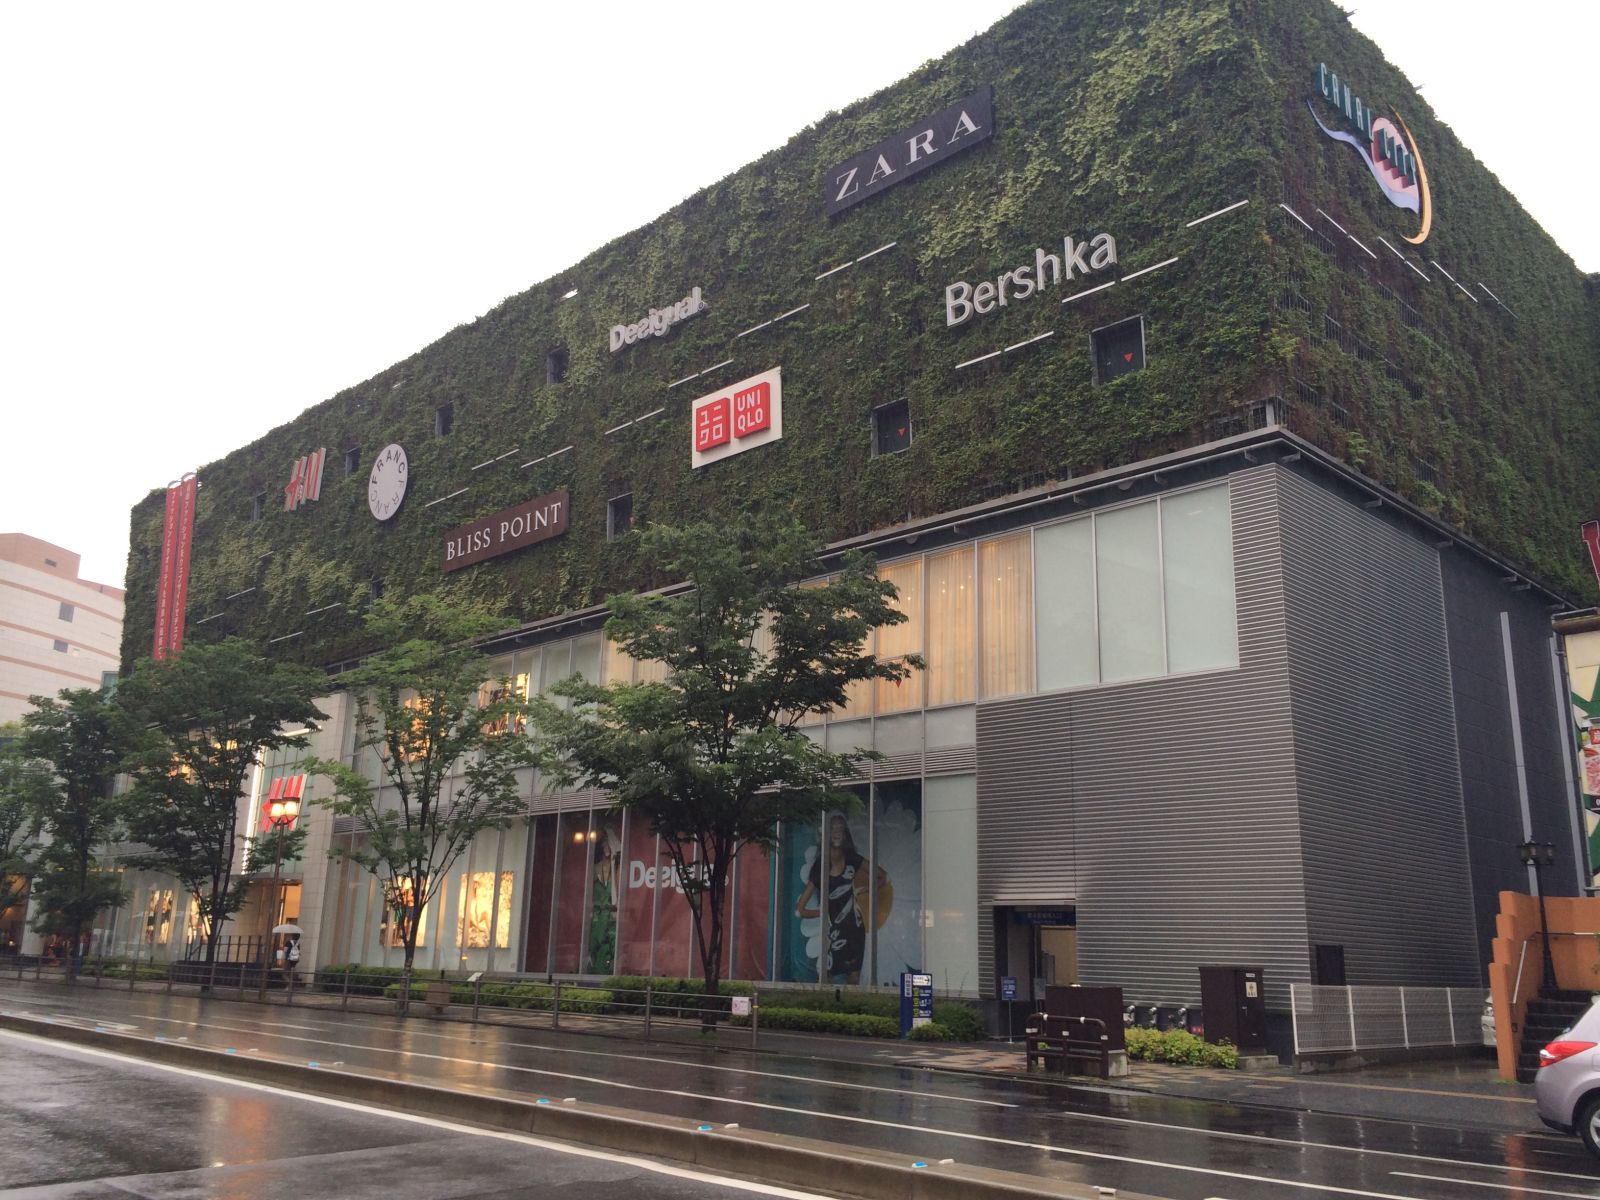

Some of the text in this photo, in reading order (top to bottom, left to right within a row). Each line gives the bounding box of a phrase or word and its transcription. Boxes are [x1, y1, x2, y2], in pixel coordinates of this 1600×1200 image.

[834, 109, 982, 203] ZARA
[1319, 62, 1417, 186] CANAL CITY
[945, 232, 1118, 327] Bershka
[609, 286, 703, 353] Desigual
[283, 447, 327, 513] H&M
[446, 501, 562, 561] BLISS POINT
[258, 773, 308, 833] HM
